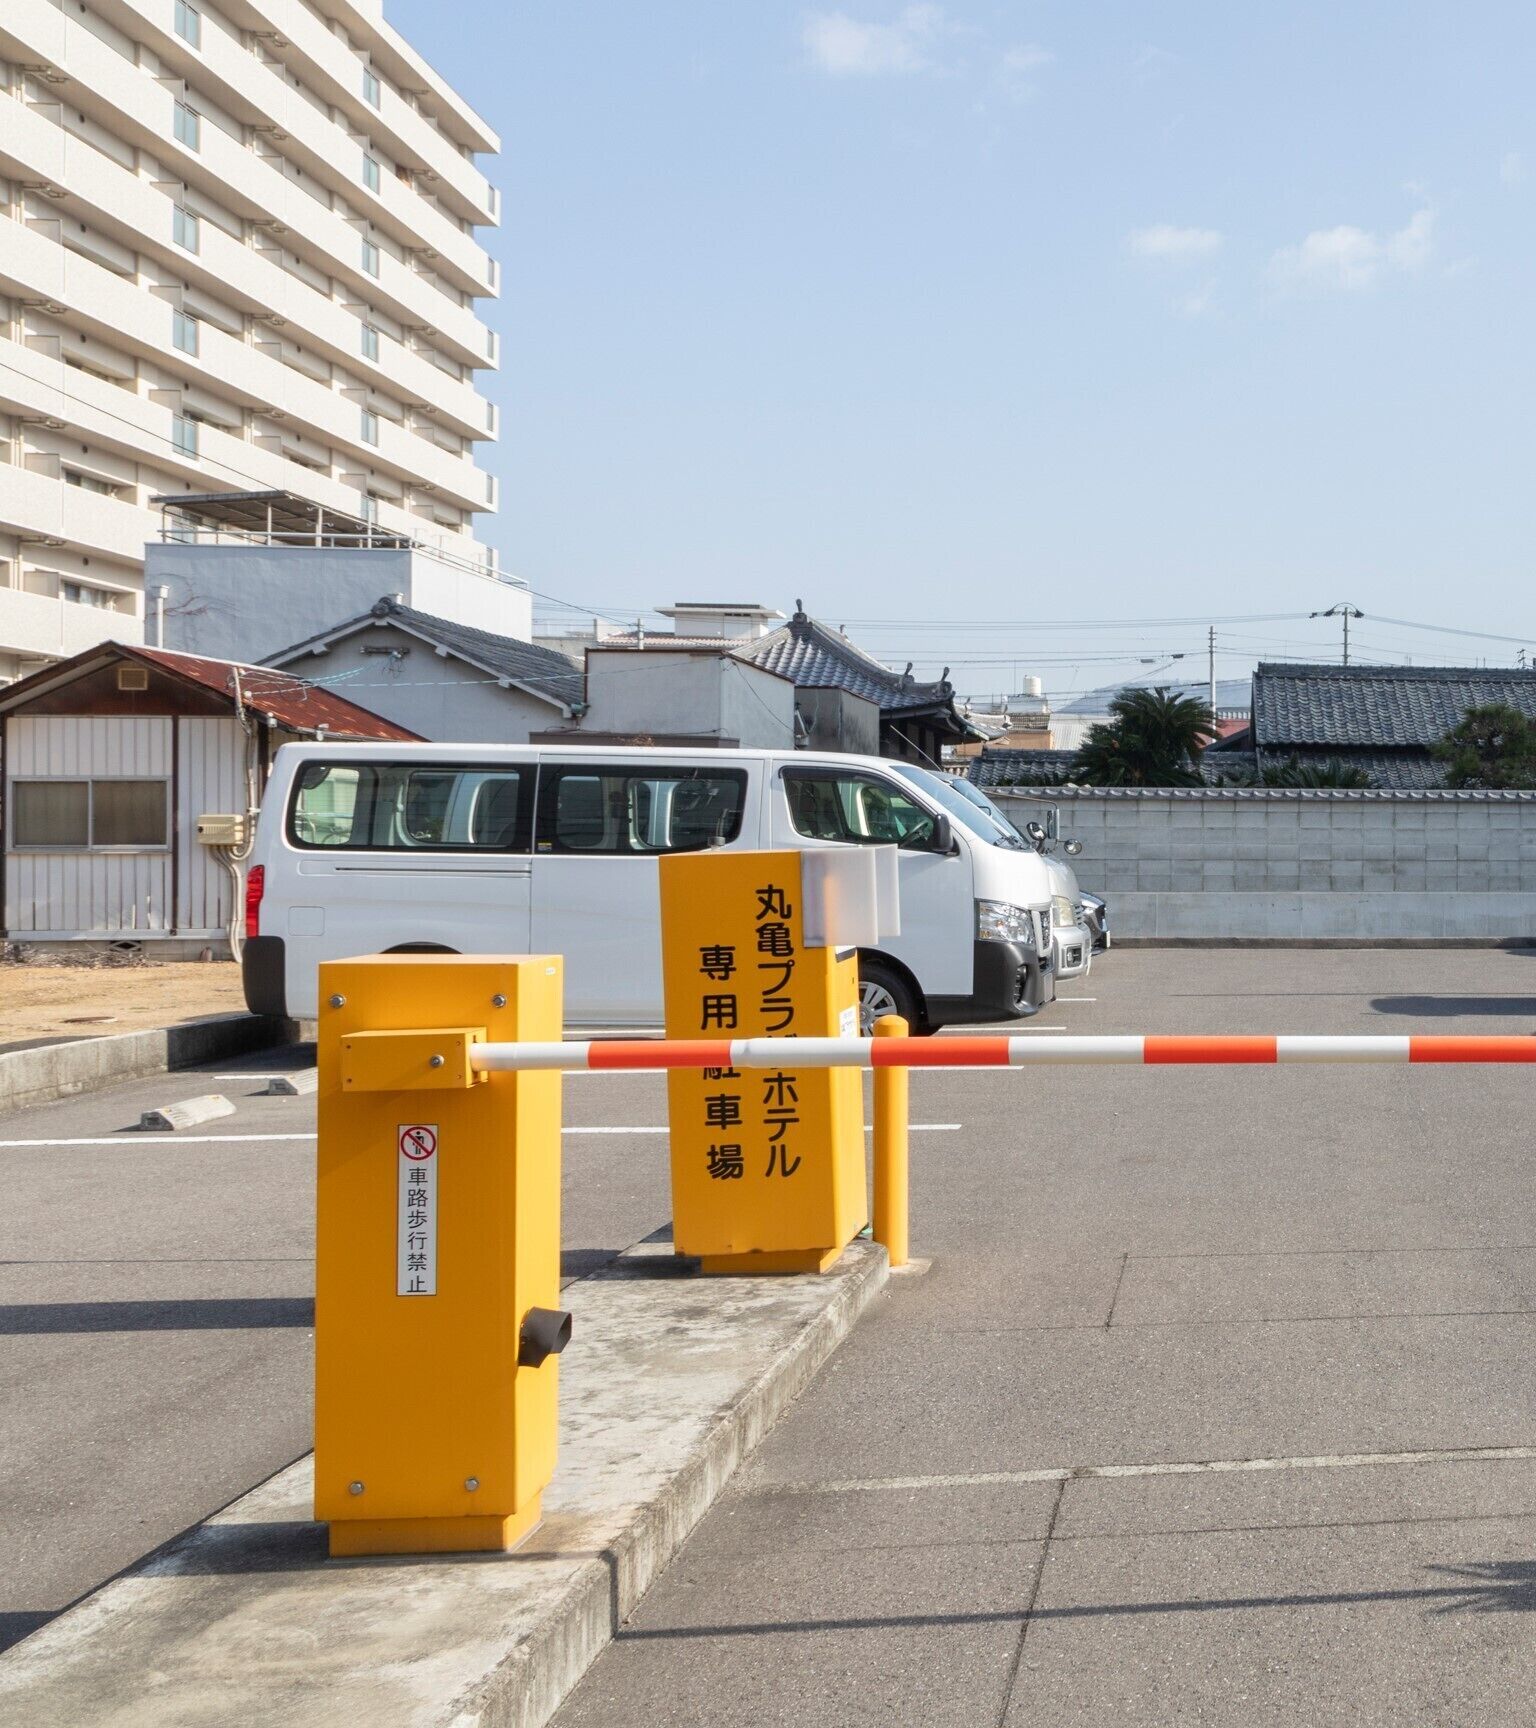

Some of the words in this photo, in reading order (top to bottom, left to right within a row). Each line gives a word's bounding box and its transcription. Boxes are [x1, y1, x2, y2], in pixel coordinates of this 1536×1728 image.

[698, 943, 745, 1181] 専用車場
[755, 883, 802, 1178] 丸亀プラホテル
[406, 1166, 429, 1293] 車路歩行禁止
